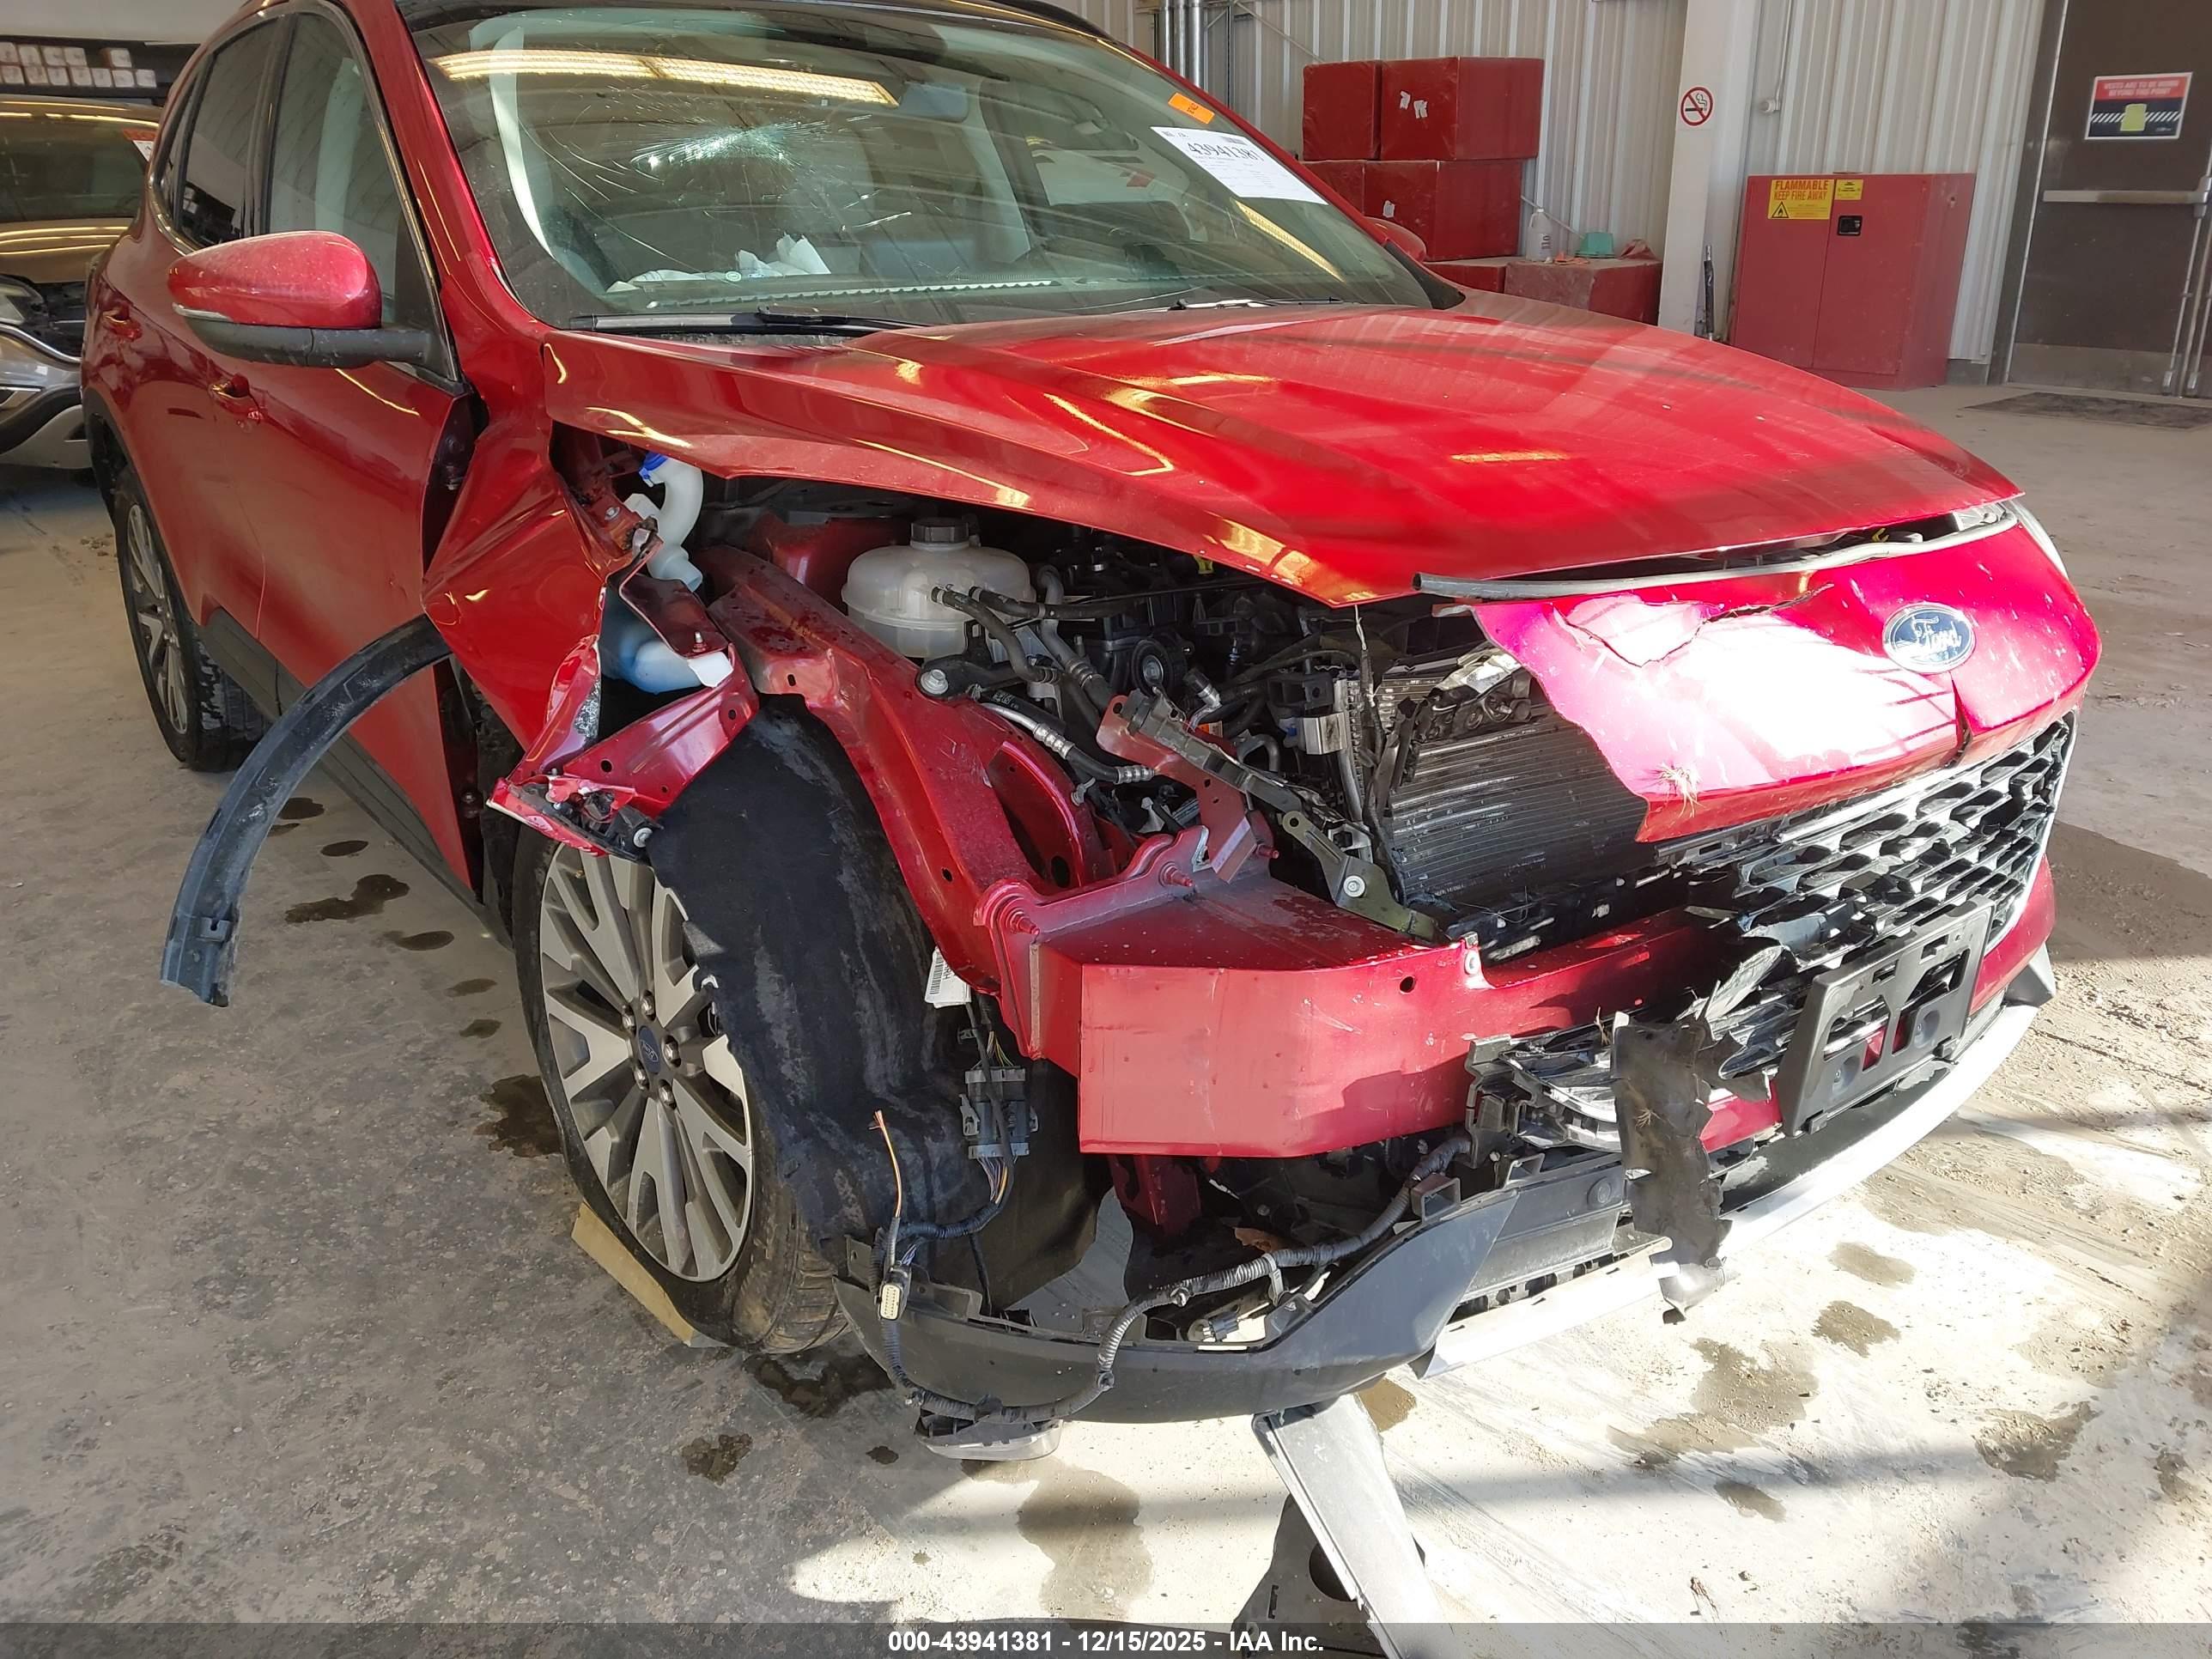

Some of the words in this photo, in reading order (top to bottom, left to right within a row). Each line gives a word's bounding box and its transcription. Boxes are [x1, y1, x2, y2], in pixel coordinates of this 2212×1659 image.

[1775, 180, 1829, 191] FLAMMABLE
[1773, 191, 1790, 200] KEEP
[1791, 191, 1807, 200] FIRE
[1808, 191, 1827, 200] AWAY
[1894, 614, 1962, 656] Ford
